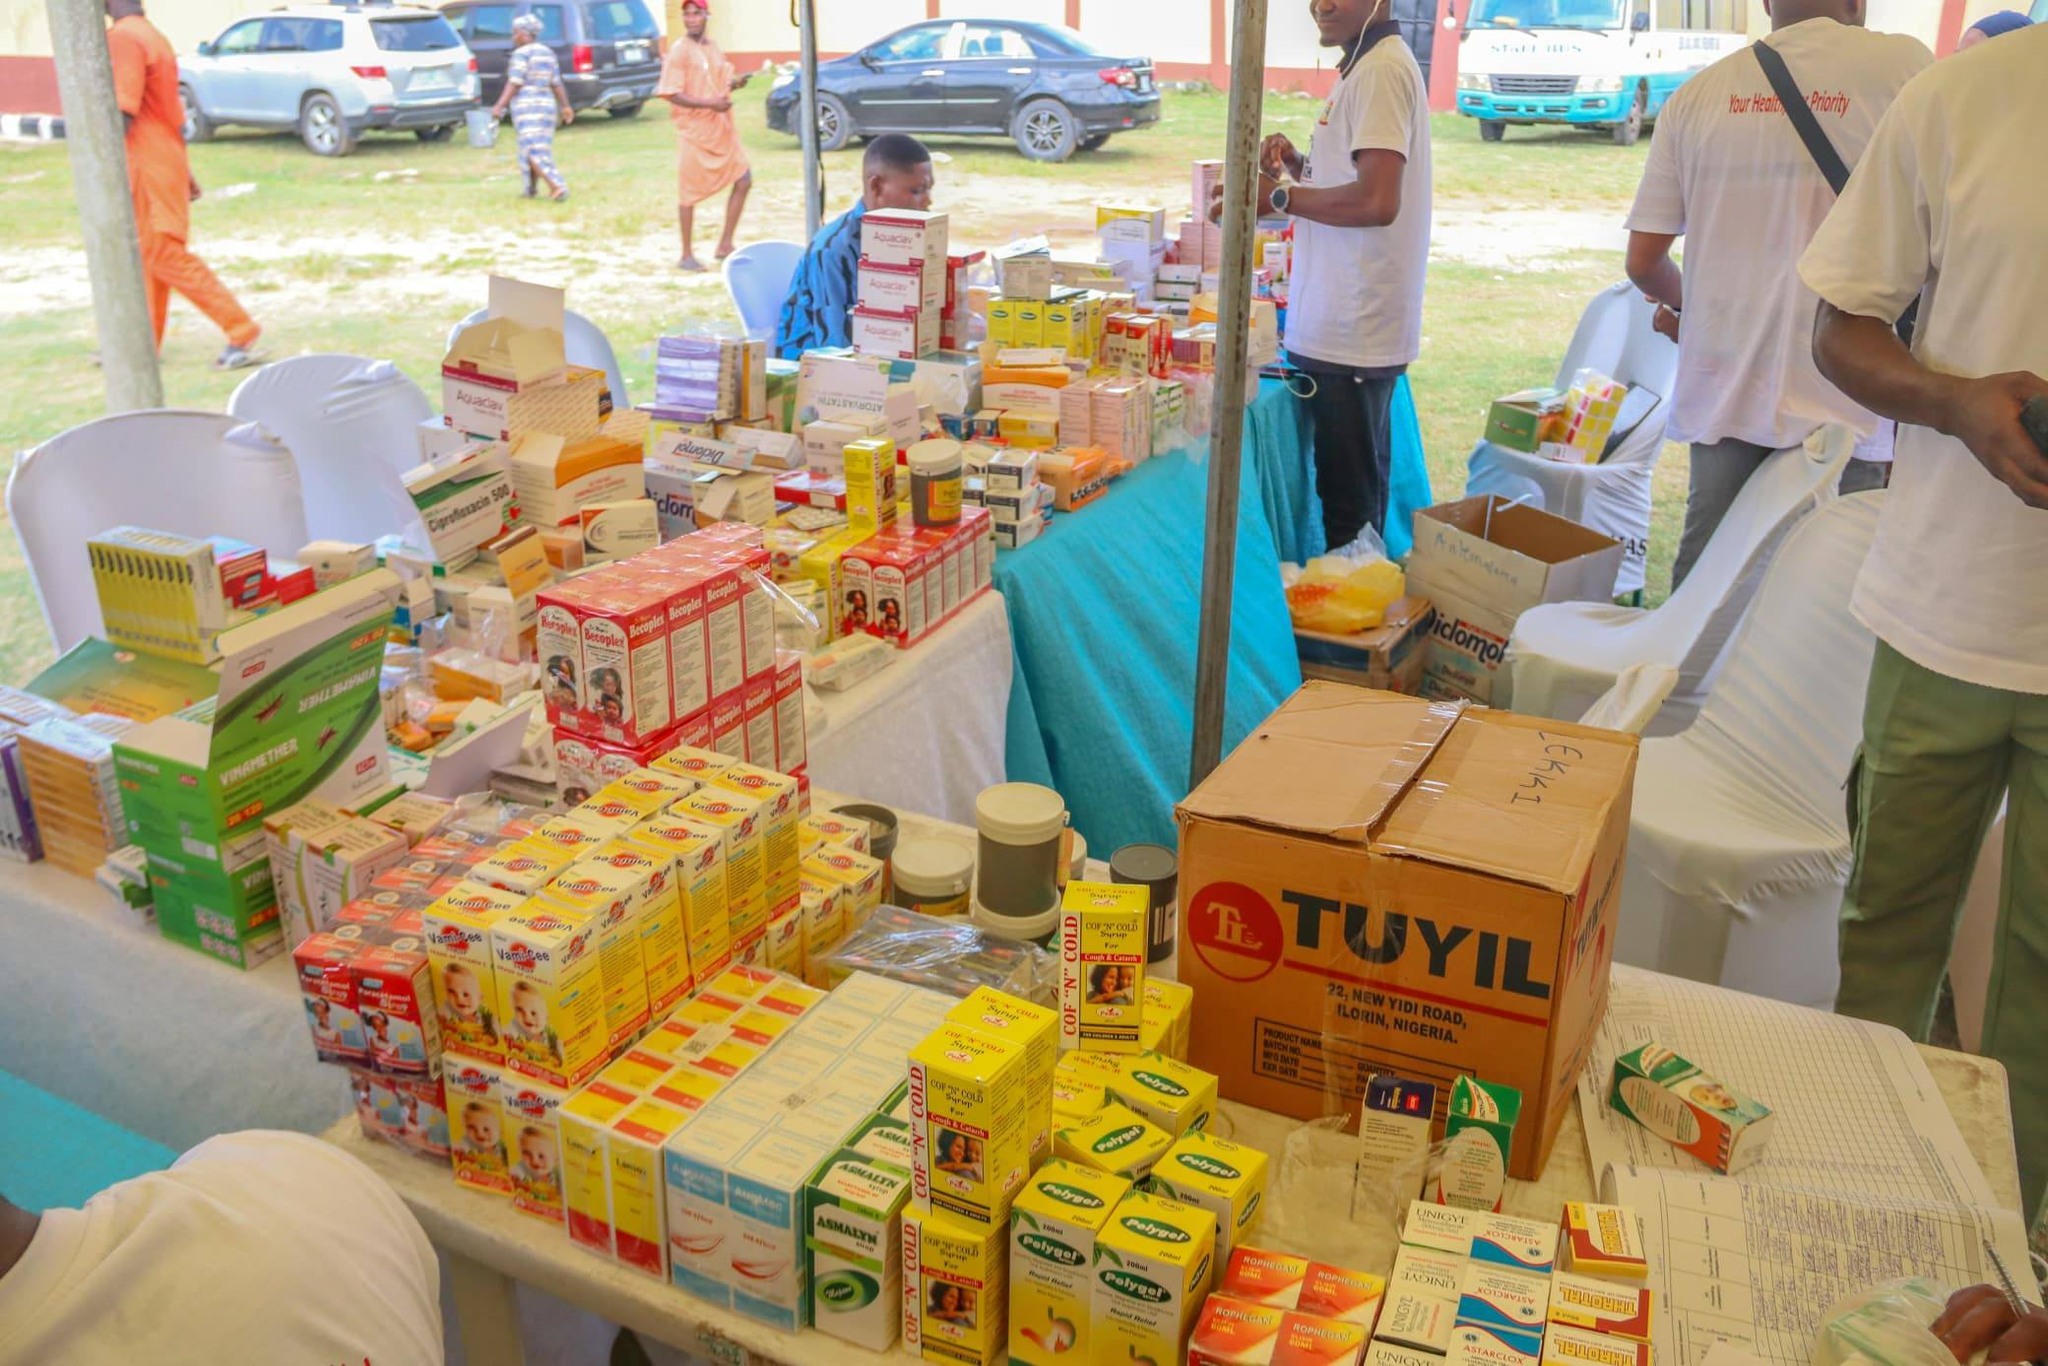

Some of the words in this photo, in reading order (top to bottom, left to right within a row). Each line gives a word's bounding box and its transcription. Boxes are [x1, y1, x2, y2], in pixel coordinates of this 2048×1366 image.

[1729, 93, 1751, 113] Your
[1811, 90, 1849, 118] Priority
[873, 231, 912, 245] Aquaclav
[869, 278, 908, 292] Aquaclav
[864, 323, 901, 337] Aquaclav
[456, 388, 504, 412] Aquaclav
[817, 395, 883, 412] ATORVASTATIN
[428, 494, 490, 533] Ciprofloxacin
[490, 483, 510, 503] 500
[706, 579, 739, 604] Becoplex
[669, 596, 703, 621] Becoplex
[541, 616, 577, 637] Becoplex
[629, 614, 665, 638] Becoplex
[584, 627, 625, 649] Becoplex
[298, 666, 377, 713] VINAMETHER
[713, 704, 742, 727] Becoplex
[219, 737, 299, 786] VINAMETHER
[669, 757, 724, 770] Vami-Cee
[623, 778, 679, 793] Vami-Cee
[727, 773, 783, 788] Vami-Cee
[582, 803, 640, 818] Vami-Cee
[690, 801, 748, 813] Vami-Cee
[541, 828, 601, 843] Vami-Cee
[648, 826, 708, 840] Vami-Cee
[488, 859, 548, 873] Vami-Cee
[592, 853, 653, 868] Vami-Cee
[557, 879, 618, 893] Vami-Cee
[641, 865, 672, 899] Vami-Cee
[447, 896, 511, 911] Vami-Cee
[600, 893, 633, 929] Vami-Cee
[509, 916, 573, 932] Vami-Cee
[1085, 922, 1101, 930] COF
[1116, 922, 1138, 932] COLD
[428, 931, 483, 945] Vami-Cee
[1064, 915, 1079, 963] COLD
[1100, 931, 1127, 939] Syrup
[1104, 941, 1119, 949] For
[1282, 889, 1550, 999] TUYIL
[496, 948, 550, 963] Vami-Cee
[560, 928, 593, 965] Vami-Cee
[1084, 953, 1105, 963] Cough
[1106, 954, 1113, 962] &
[1113, 954, 1138, 963] Catarrh
[359, 986, 411, 1002] Paracetamol
[987, 1003, 1020, 1021] Syrup
[1328, 982, 1349, 1001] 22,
[1352, 988, 1386, 1006] NEW
[1388, 995, 1418, 1015] YIDI
[1422, 1004, 1467, 1029] ROAD,
[1063, 1003, 1078, 1036] COF
[1337, 1003, 1390, 1030] ILORIN,
[1393, 1017, 1459, 1045] NIGERIA.
[945, 1029, 961, 1039] COF
[981, 1039, 1006, 1054] COLD
[951, 1038, 984, 1056] Syrup
[1263, 1027, 1300, 1043] PRODUCT
[1299, 1037, 1322, 1050] NAME
[1263, 1040, 1288, 1054] BATCH
[1289, 1046, 1301, 1057] NO
[1262, 1050, 1279, 1063] MFG
[1280, 1055, 1300, 1067] DATE
[1278, 1066, 1298, 1078] DATE
[1356, 1062, 1396, 1077] QUANTITY
[910, 1065, 924, 1118] COLD
[930, 1078, 947, 1091] COF
[961, 1088, 984, 1104] COLD
[1137, 1072, 1186, 1096] Polygel
[945, 1093, 973, 1109] Syrup
[950, 1106, 965, 1117] For
[930, 1113, 951, 1127] Cough
[959, 1123, 985, 1137] Catarrh
[1095, 1125, 1140, 1152] Polygel
[838, 1162, 899, 1190] ASMALYN
[1180, 1154, 1236, 1178] Polygel
[869, 1183, 889, 1196] syrup
[914, 1160, 927, 1199] COF
[1042, 1183, 1099, 1207] Polygel
[1416, 1208, 1467, 1225] UNIGYL
[816, 1216, 878, 1246] ASMALYN
[1125, 1218, 1186, 1241] Polygel
[1485, 1230, 1542, 1246] ASTARCLOX
[904, 1223, 917, 1271] COLD
[1022, 1234, 1078, 1262] Polygel
[1159, 1250, 1182, 1261] 200ml
[1126, 1259, 1148, 1272] 200ml
[1243, 1255, 1298, 1275] ROPHEGAN
[1029, 1269, 1051, 1282] Rapid
[1051, 1278, 1073, 1289] Relief
[1104, 1271, 1163, 1298] Polygel
[1317, 1270, 1372, 1291] ROPHEGAN
[1477, 1286, 1535, 1304] ASTARCLOX
[1559, 1285, 1638, 1317] THROTAL
[1110, 1307, 1132, 1320] Rapid
[1133, 1315, 1157, 1327] Relief
[1215, 1306, 1272, 1325] ROPHEGAN
[1390, 1294, 1414, 1333] UNIGYL
[905, 1310, 918, 1344] COF
[1293, 1322, 1350, 1341] ROPHEGAN
[1463, 1344, 1525, 1365] ASTARCLOX
[1553, 1337, 1634, 1366] THROTAL
